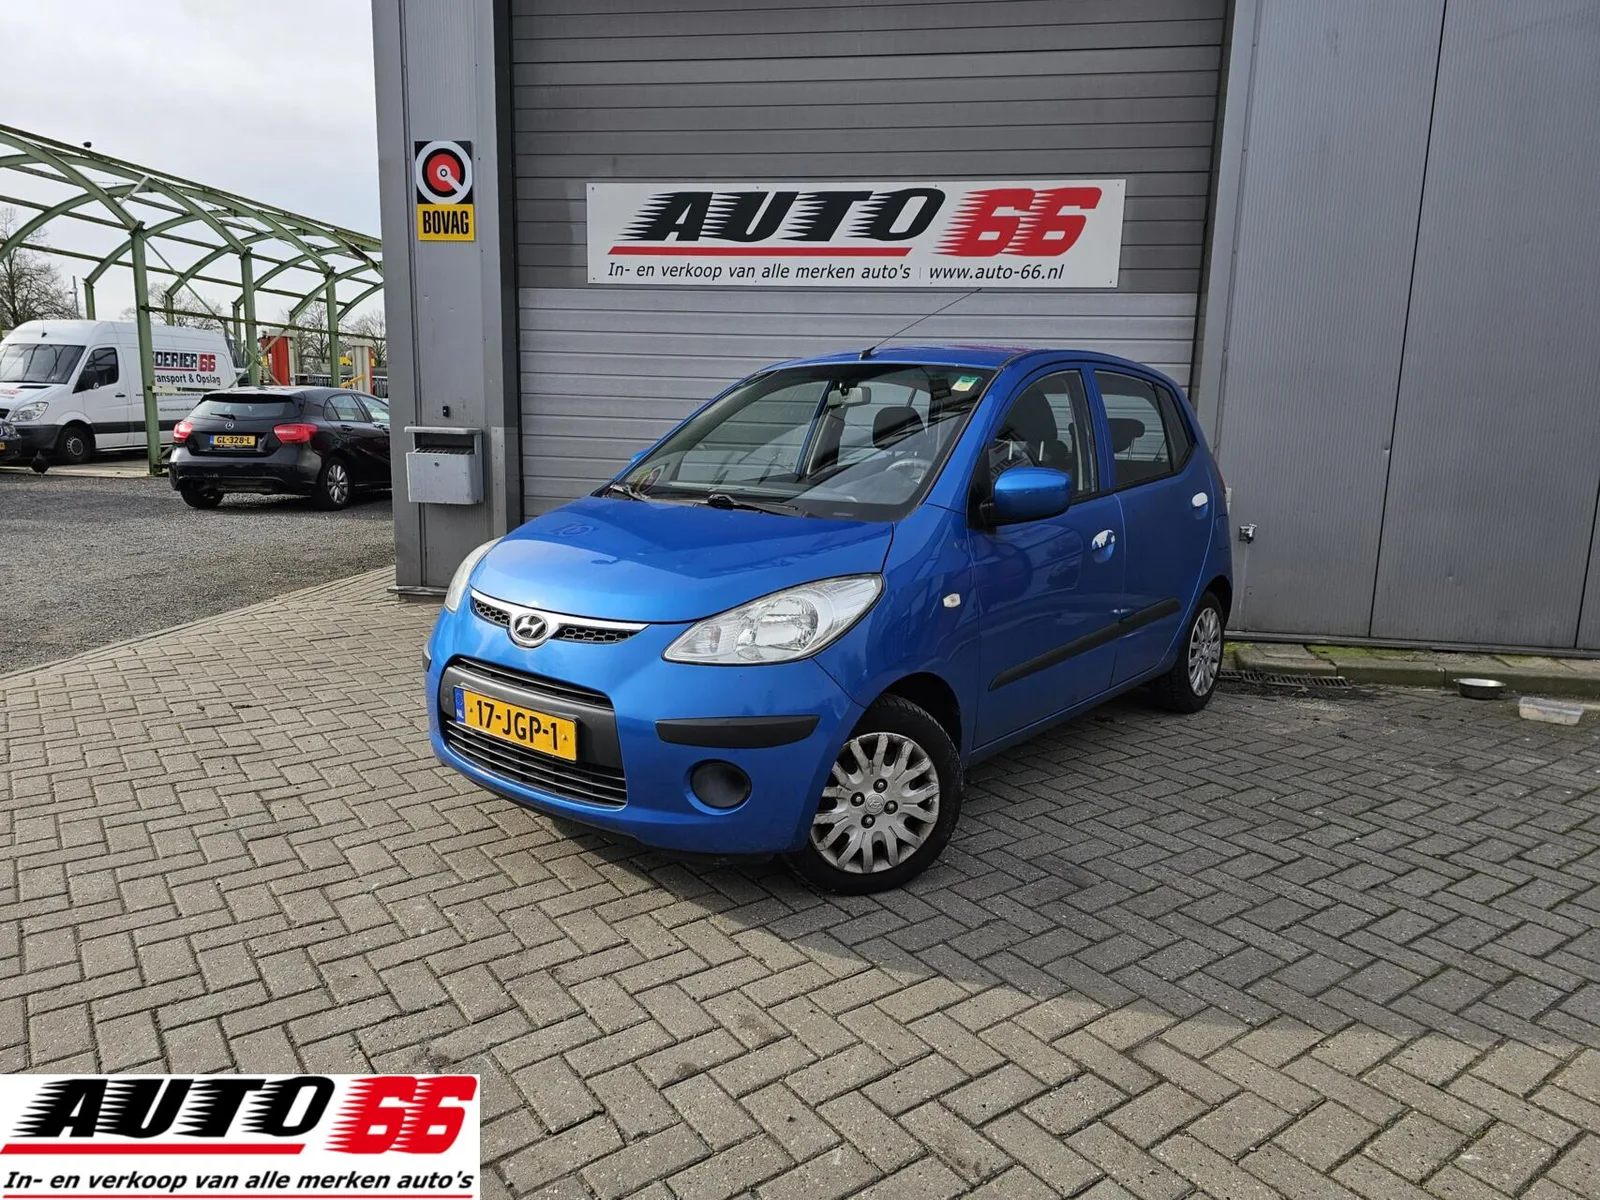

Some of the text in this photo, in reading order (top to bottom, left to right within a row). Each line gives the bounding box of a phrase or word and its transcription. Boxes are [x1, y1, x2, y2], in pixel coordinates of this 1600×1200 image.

[422, 209, 470, 235] BOVAG
[613, 186, 1102, 257] AUTO 66
[607, 262, 1065, 282] In- en verkoop van alle merken auto's www.auto-66.nl
[196, 374, 221, 386] Opslag
[216, 436, 252, 444] GL-328-L
[476, 700, 558, 751] 17-JGP-1
